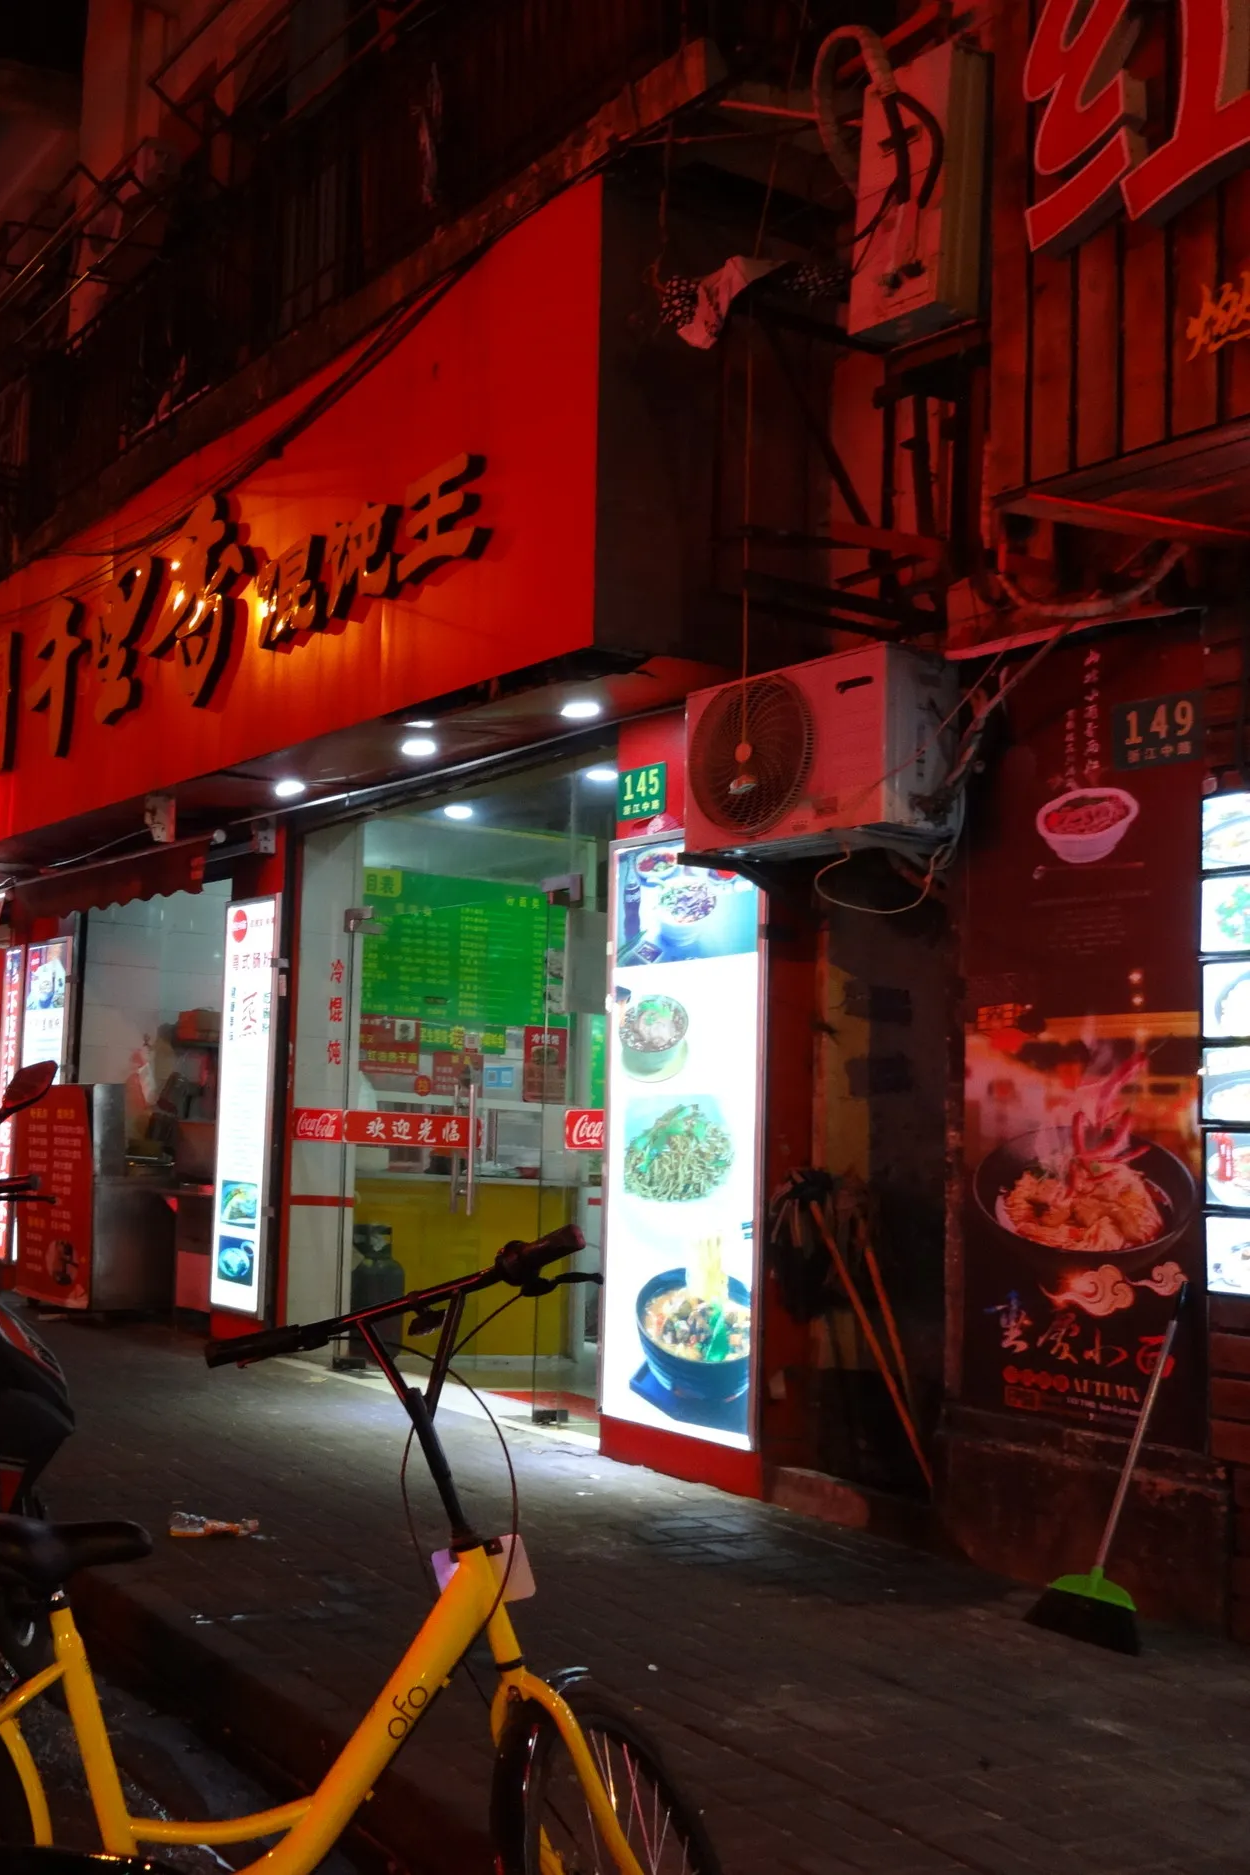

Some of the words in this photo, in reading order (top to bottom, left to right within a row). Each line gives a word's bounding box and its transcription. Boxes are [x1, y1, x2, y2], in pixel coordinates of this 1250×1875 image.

[1124, 700, 1195, 746] 149
[1126, 741, 1192, 764] 浙江中路
[623, 768, 660, 801] 145
[622, 799, 661, 815] 浙江中路
[365, 1116, 462, 1143] 欢迎光临
[387, 1686, 429, 1740] ofo
